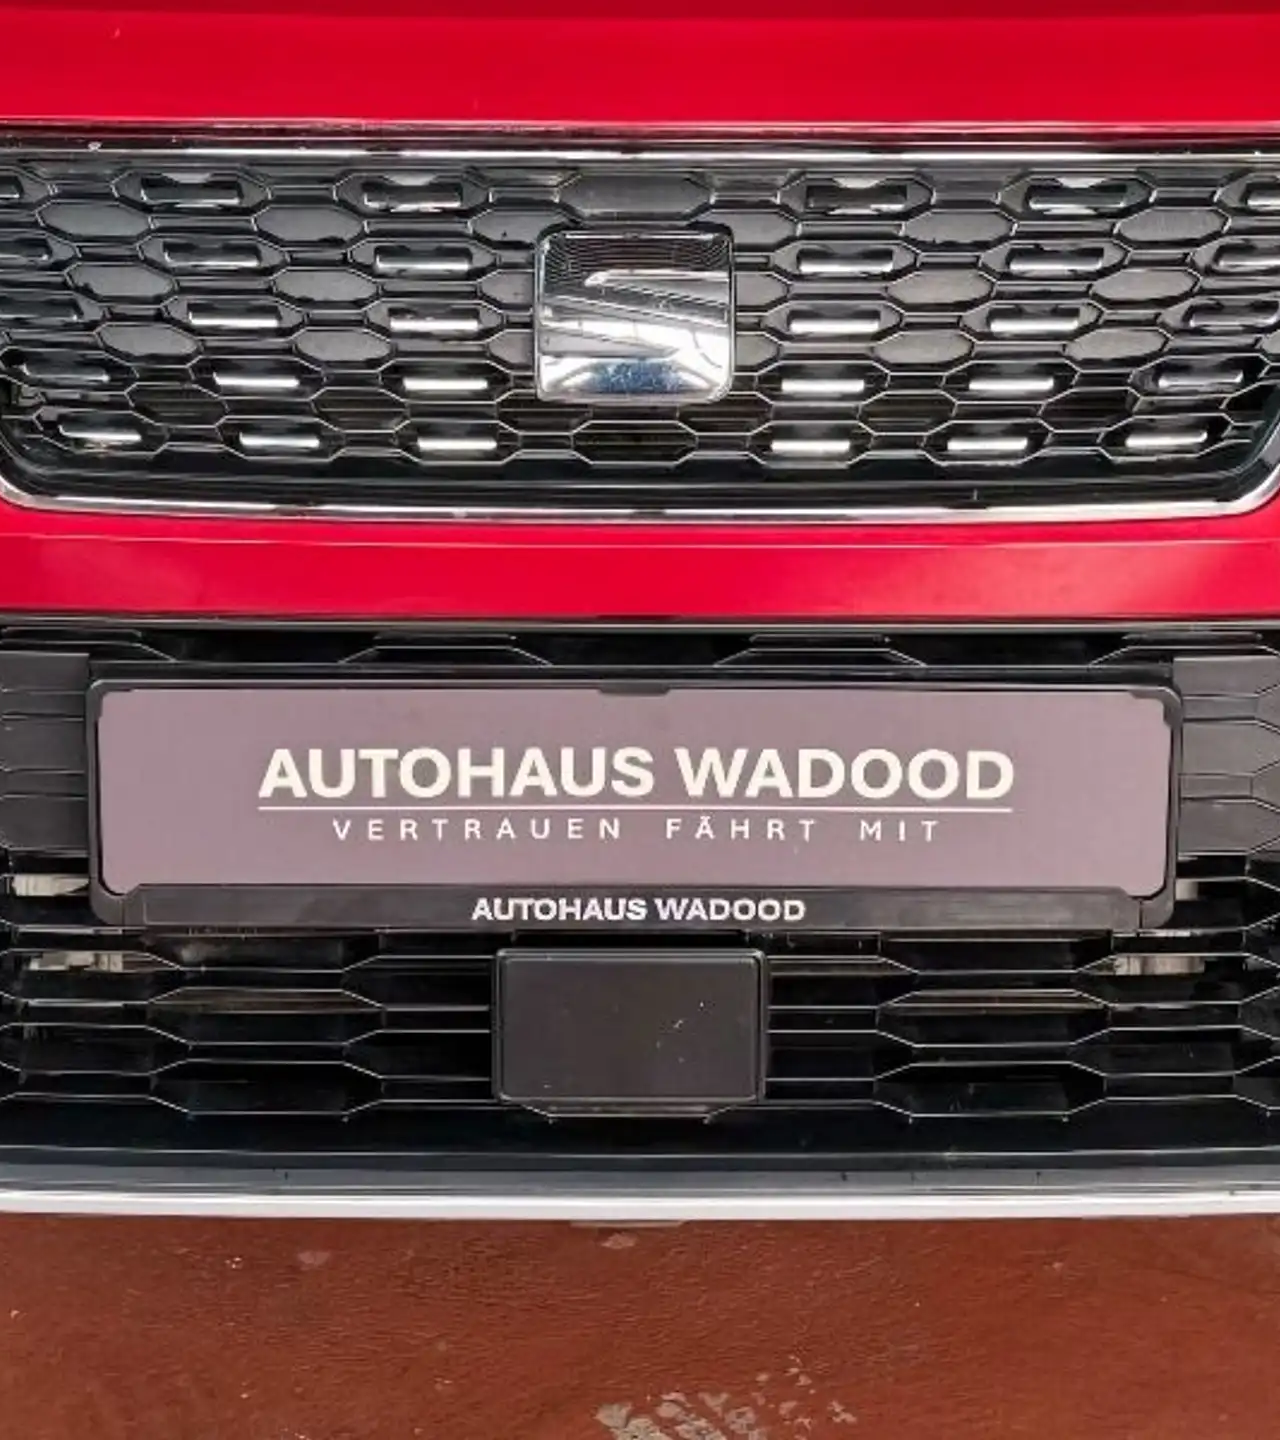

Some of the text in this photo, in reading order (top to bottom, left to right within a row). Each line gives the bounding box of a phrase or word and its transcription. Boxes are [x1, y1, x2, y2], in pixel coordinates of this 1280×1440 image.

[258, 747, 1015, 800] AUTOHAUS WADOOD
[332, 814, 940, 842] VERTRAUEN FÄHRT MIT
[471, 897, 806, 922] AUTOHAUS WADOOD
